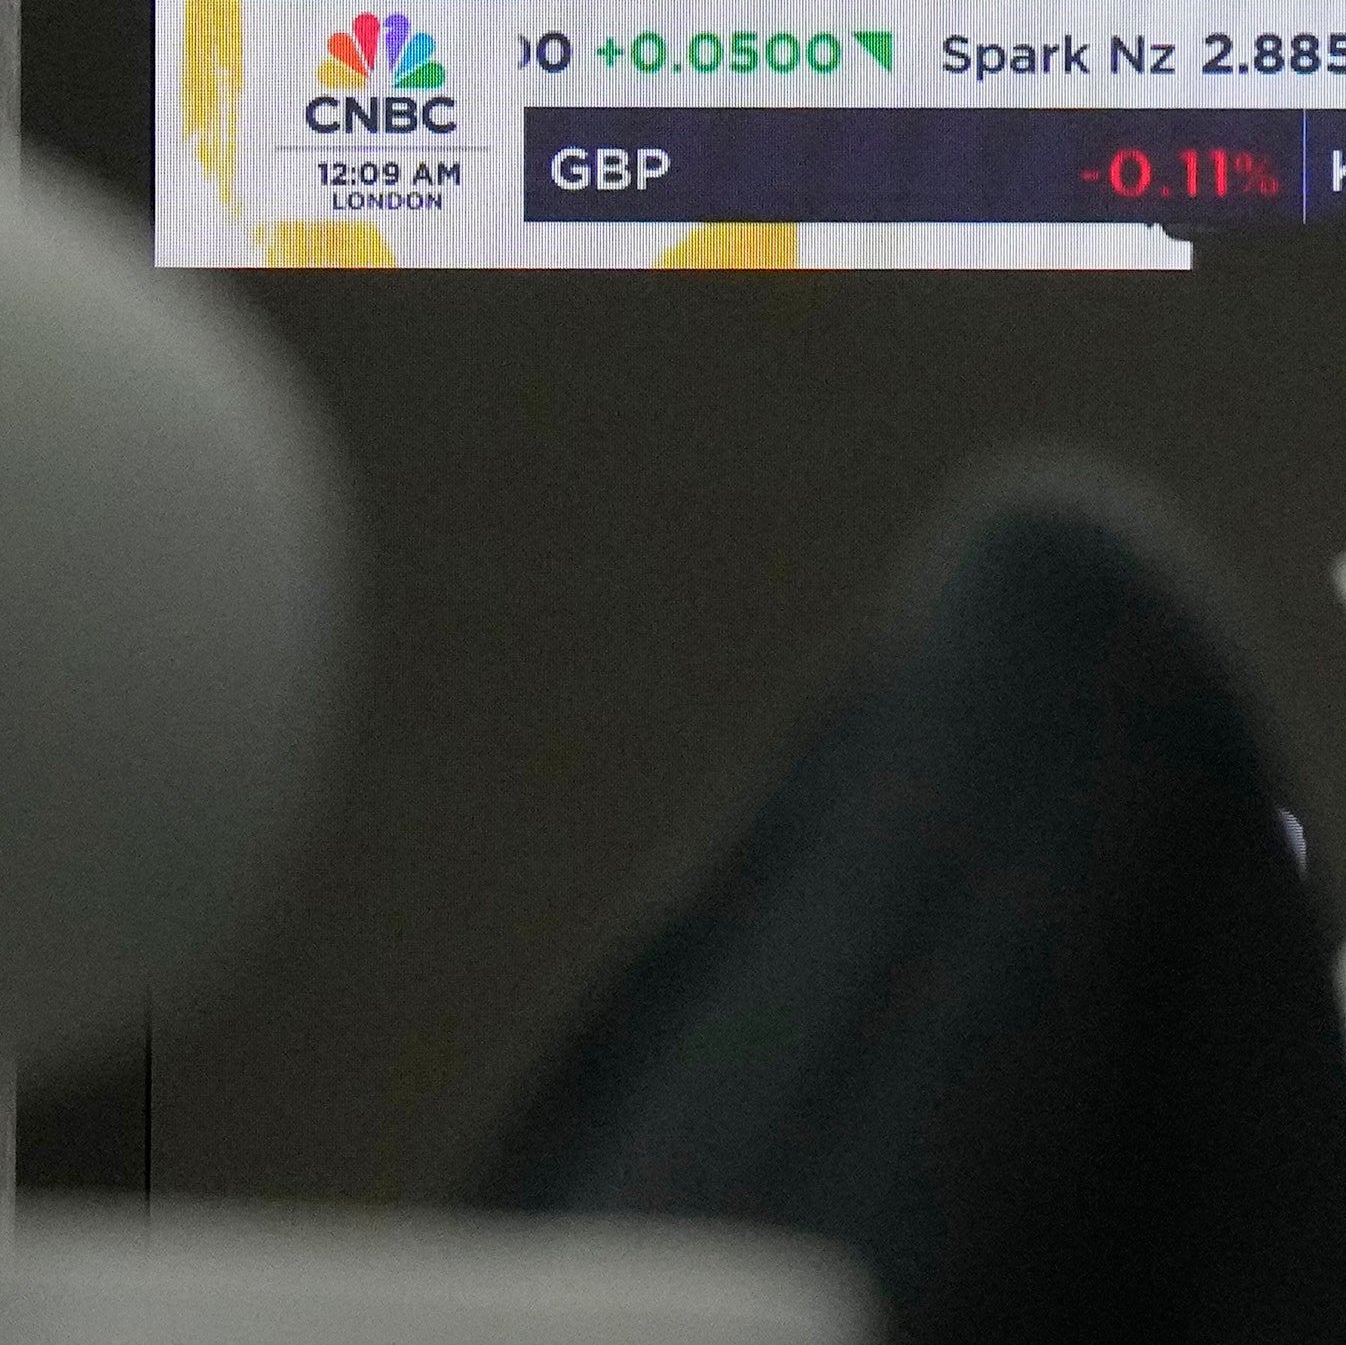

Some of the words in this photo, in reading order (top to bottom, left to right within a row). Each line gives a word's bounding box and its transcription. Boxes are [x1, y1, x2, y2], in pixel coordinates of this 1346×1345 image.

[596, 31, 843, 75] +0.0500
[942, 35, 1089, 81] Spark
[1110, 36, 1175, 75] Nz
[304, 96, 457, 135] CNBC
[318, 162, 400, 186] 12:09
[412, 162, 462, 186] AM
[550, 147, 671, 191] GBP
[1082, 150, 1280, 198] -0.11%
[331, 192, 443, 211] LONDON
